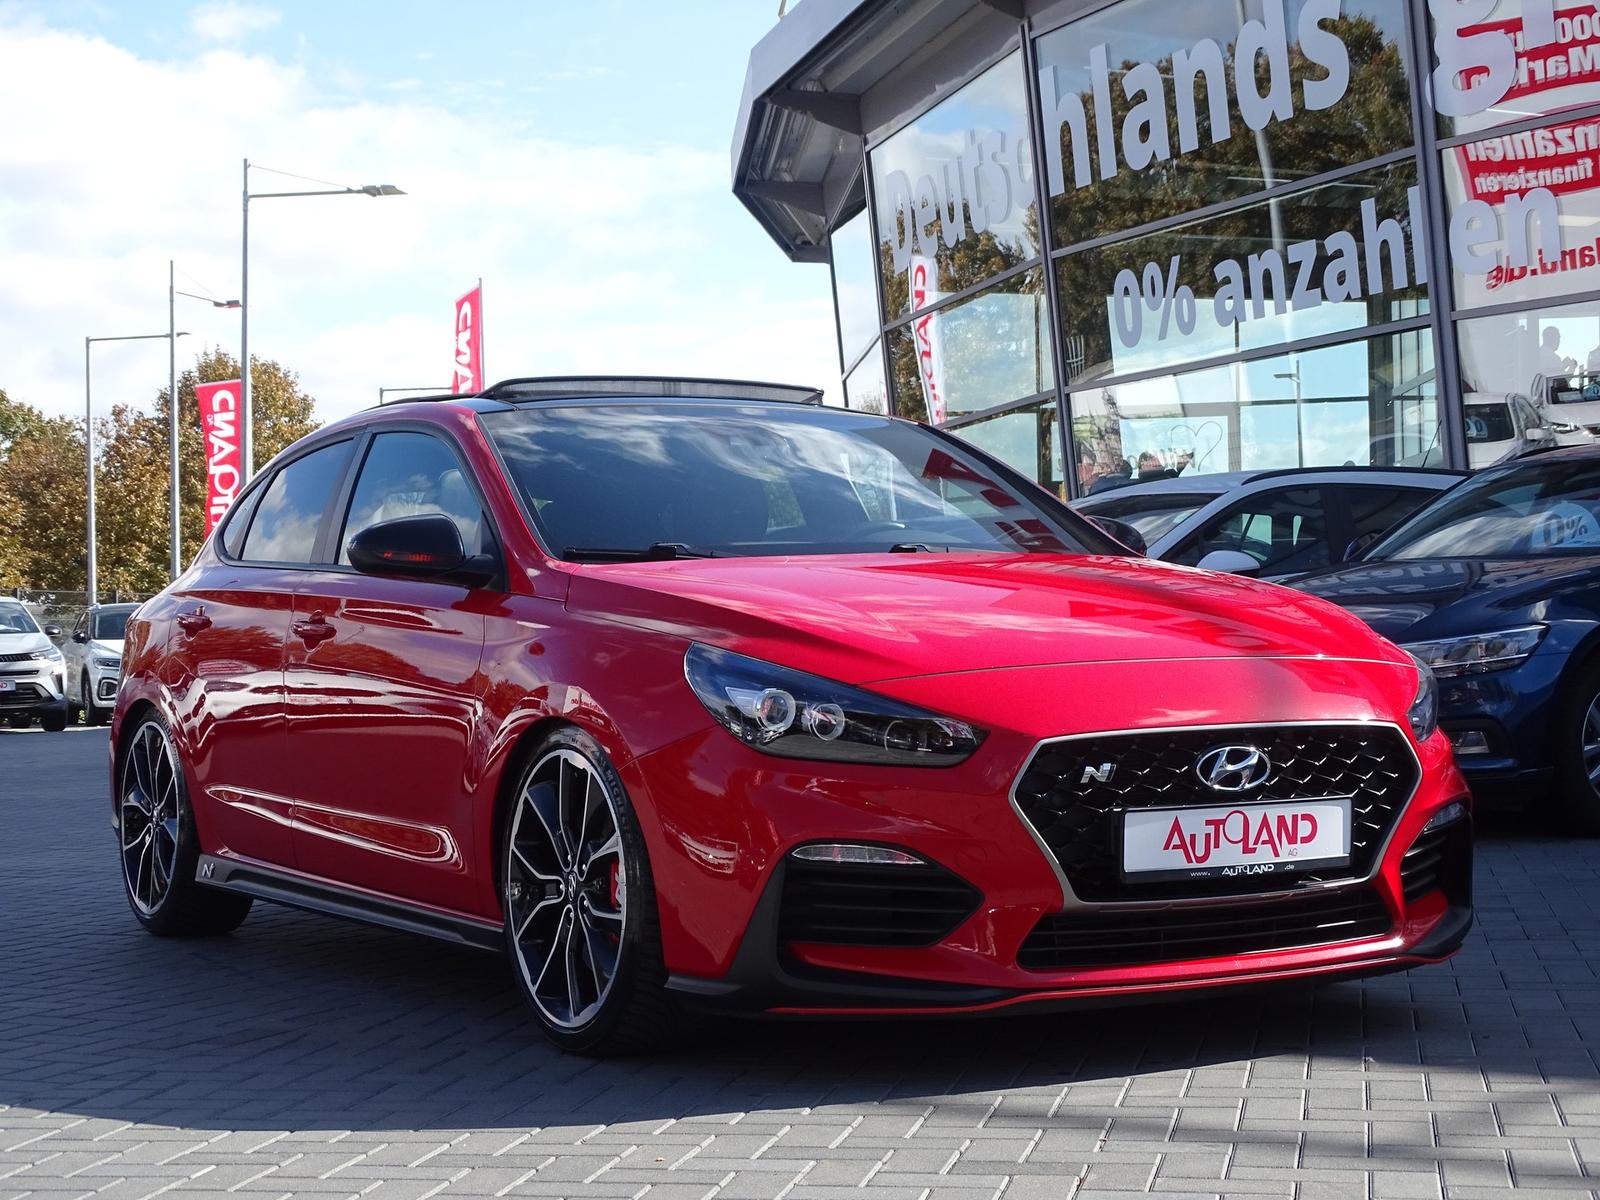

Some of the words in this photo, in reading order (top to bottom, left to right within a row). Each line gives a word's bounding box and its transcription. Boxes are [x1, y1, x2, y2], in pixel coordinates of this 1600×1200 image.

[886, 0, 1351, 273] Deutschlands
[1113, 255, 1196, 348] 0%
[1213, 185, 1559, 328] anzahlen
[1163, 810, 1318, 864] AUTOLAND
[1288, 848, 1298, 857] AG
[1221, 864, 1275, 876] AUTOLAND
